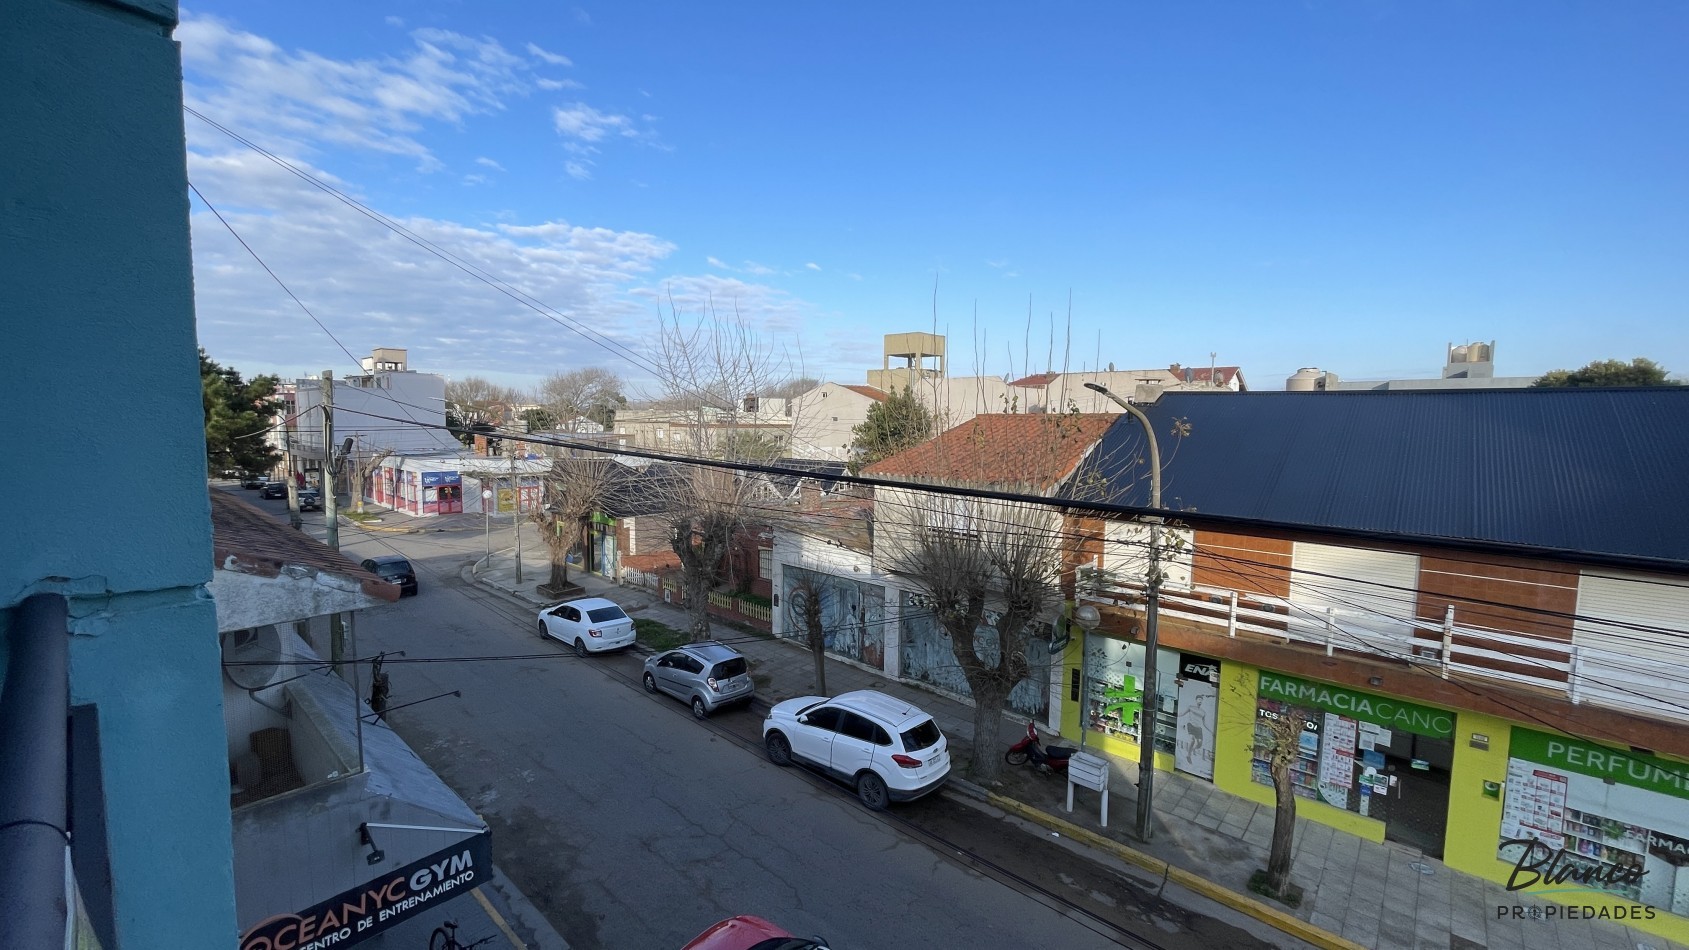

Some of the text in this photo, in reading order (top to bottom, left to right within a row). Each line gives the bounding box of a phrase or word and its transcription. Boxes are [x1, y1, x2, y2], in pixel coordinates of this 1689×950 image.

[1260, 676, 1452, 733] FARMACIA CANO
[1624, 829, 1689, 855] FARMA
[409, 849, 473, 891] GYM
[357, 916, 374, 932] DE
[379, 870, 475, 922] ENTRENAMIENTO
